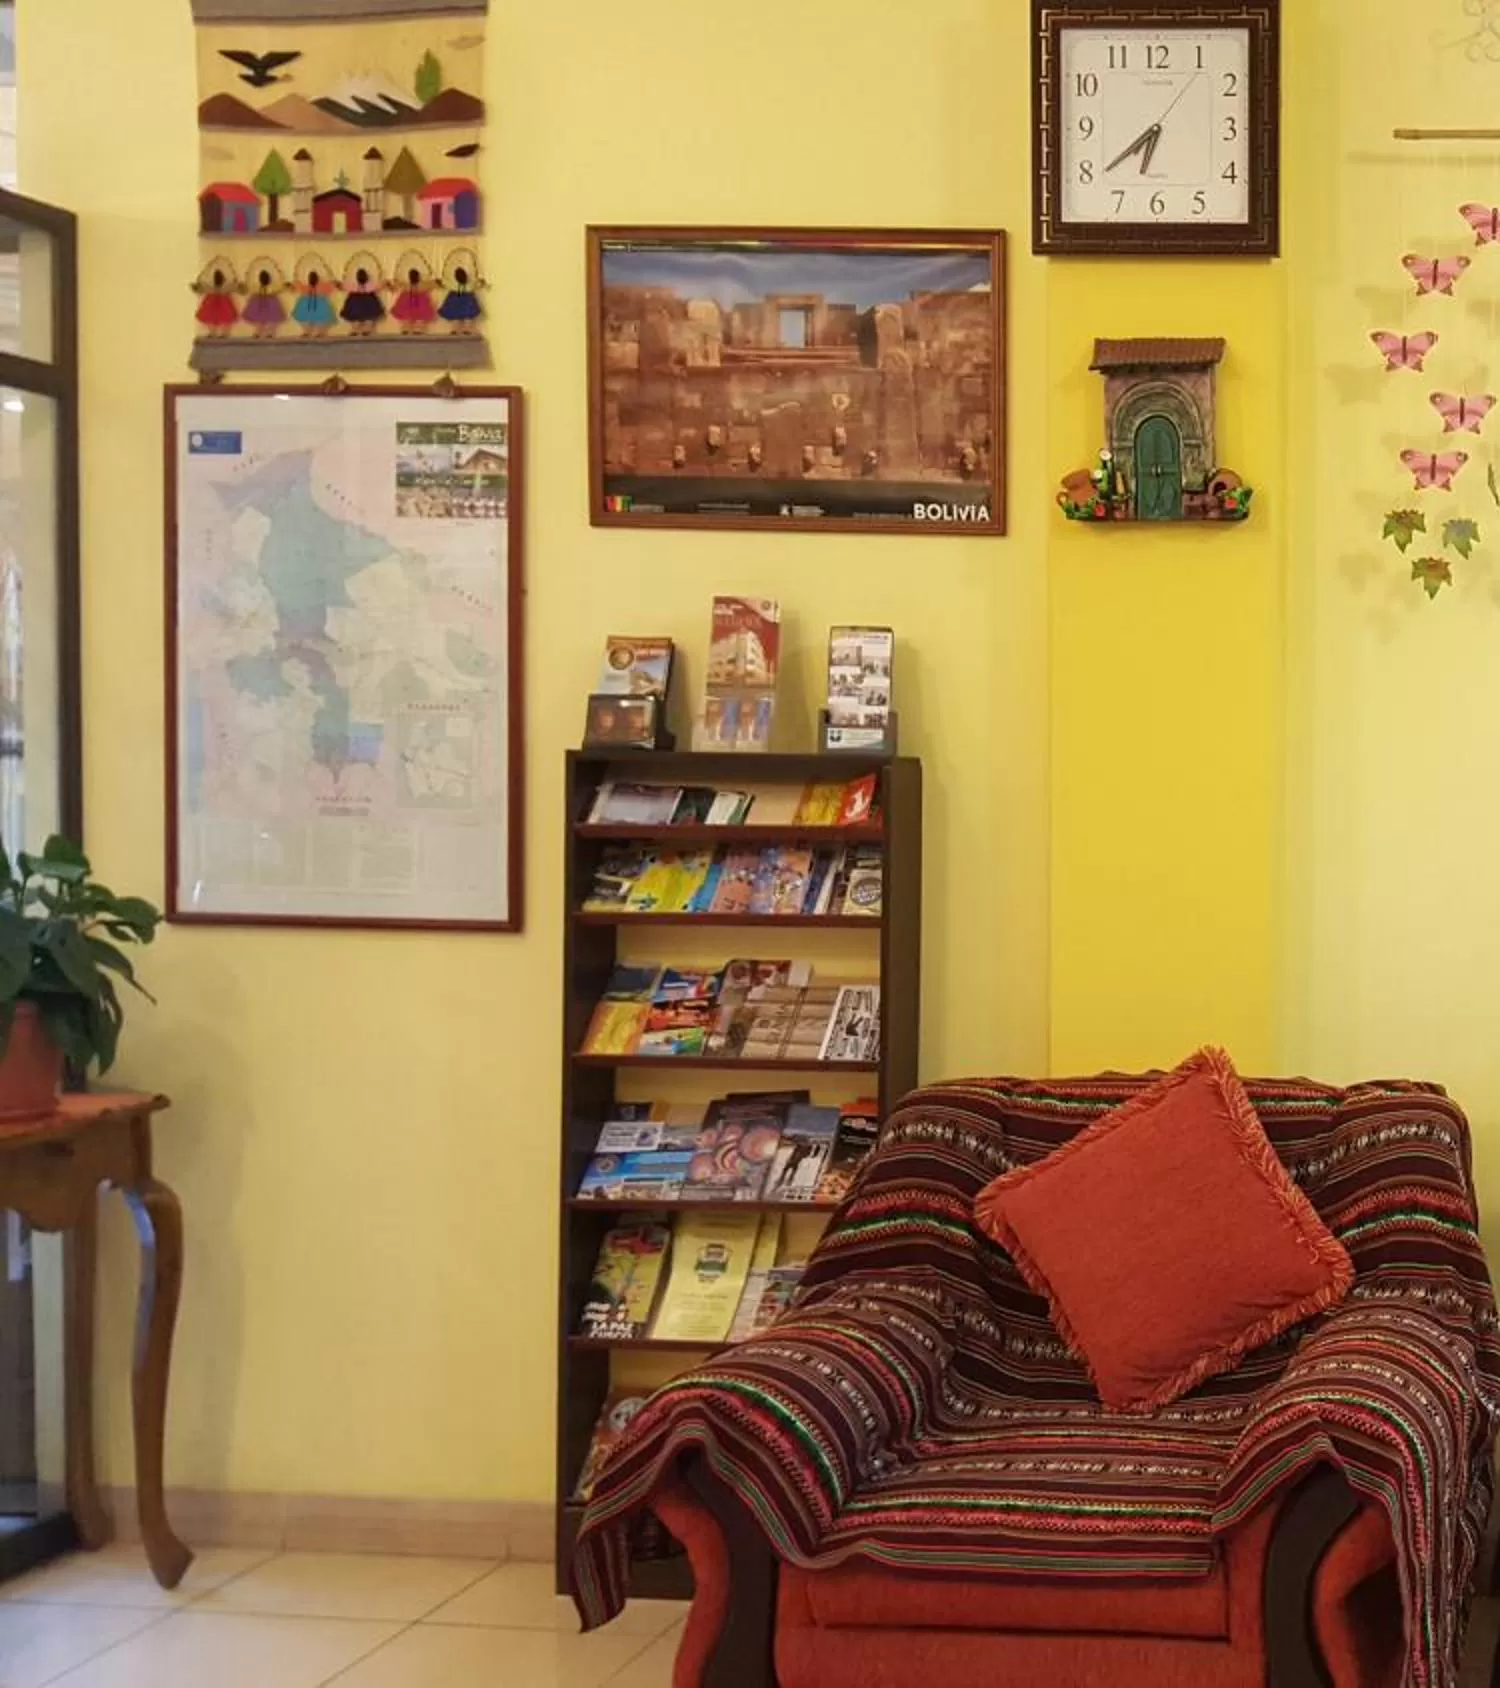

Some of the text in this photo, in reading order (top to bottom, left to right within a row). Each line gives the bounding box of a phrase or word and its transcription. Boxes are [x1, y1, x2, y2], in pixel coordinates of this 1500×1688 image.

[1108, 45, 1127, 69] 11
[1146, 45, 1170, 69] 12
[1195, 45, 1203, 69] 1
[1075, 73, 1099, 97] 10
[1222, 73, 1238, 97] 2
[1078, 116, 1094, 141] 9
[1222, 117, 1238, 141] 3
[1079, 160, 1094, 185] 8
[1221, 161, 1239, 185] 4
[1110, 190, 1125, 214] 7
[1149, 191, 1166, 215] 6
[1191, 191, 1206, 215] 5
